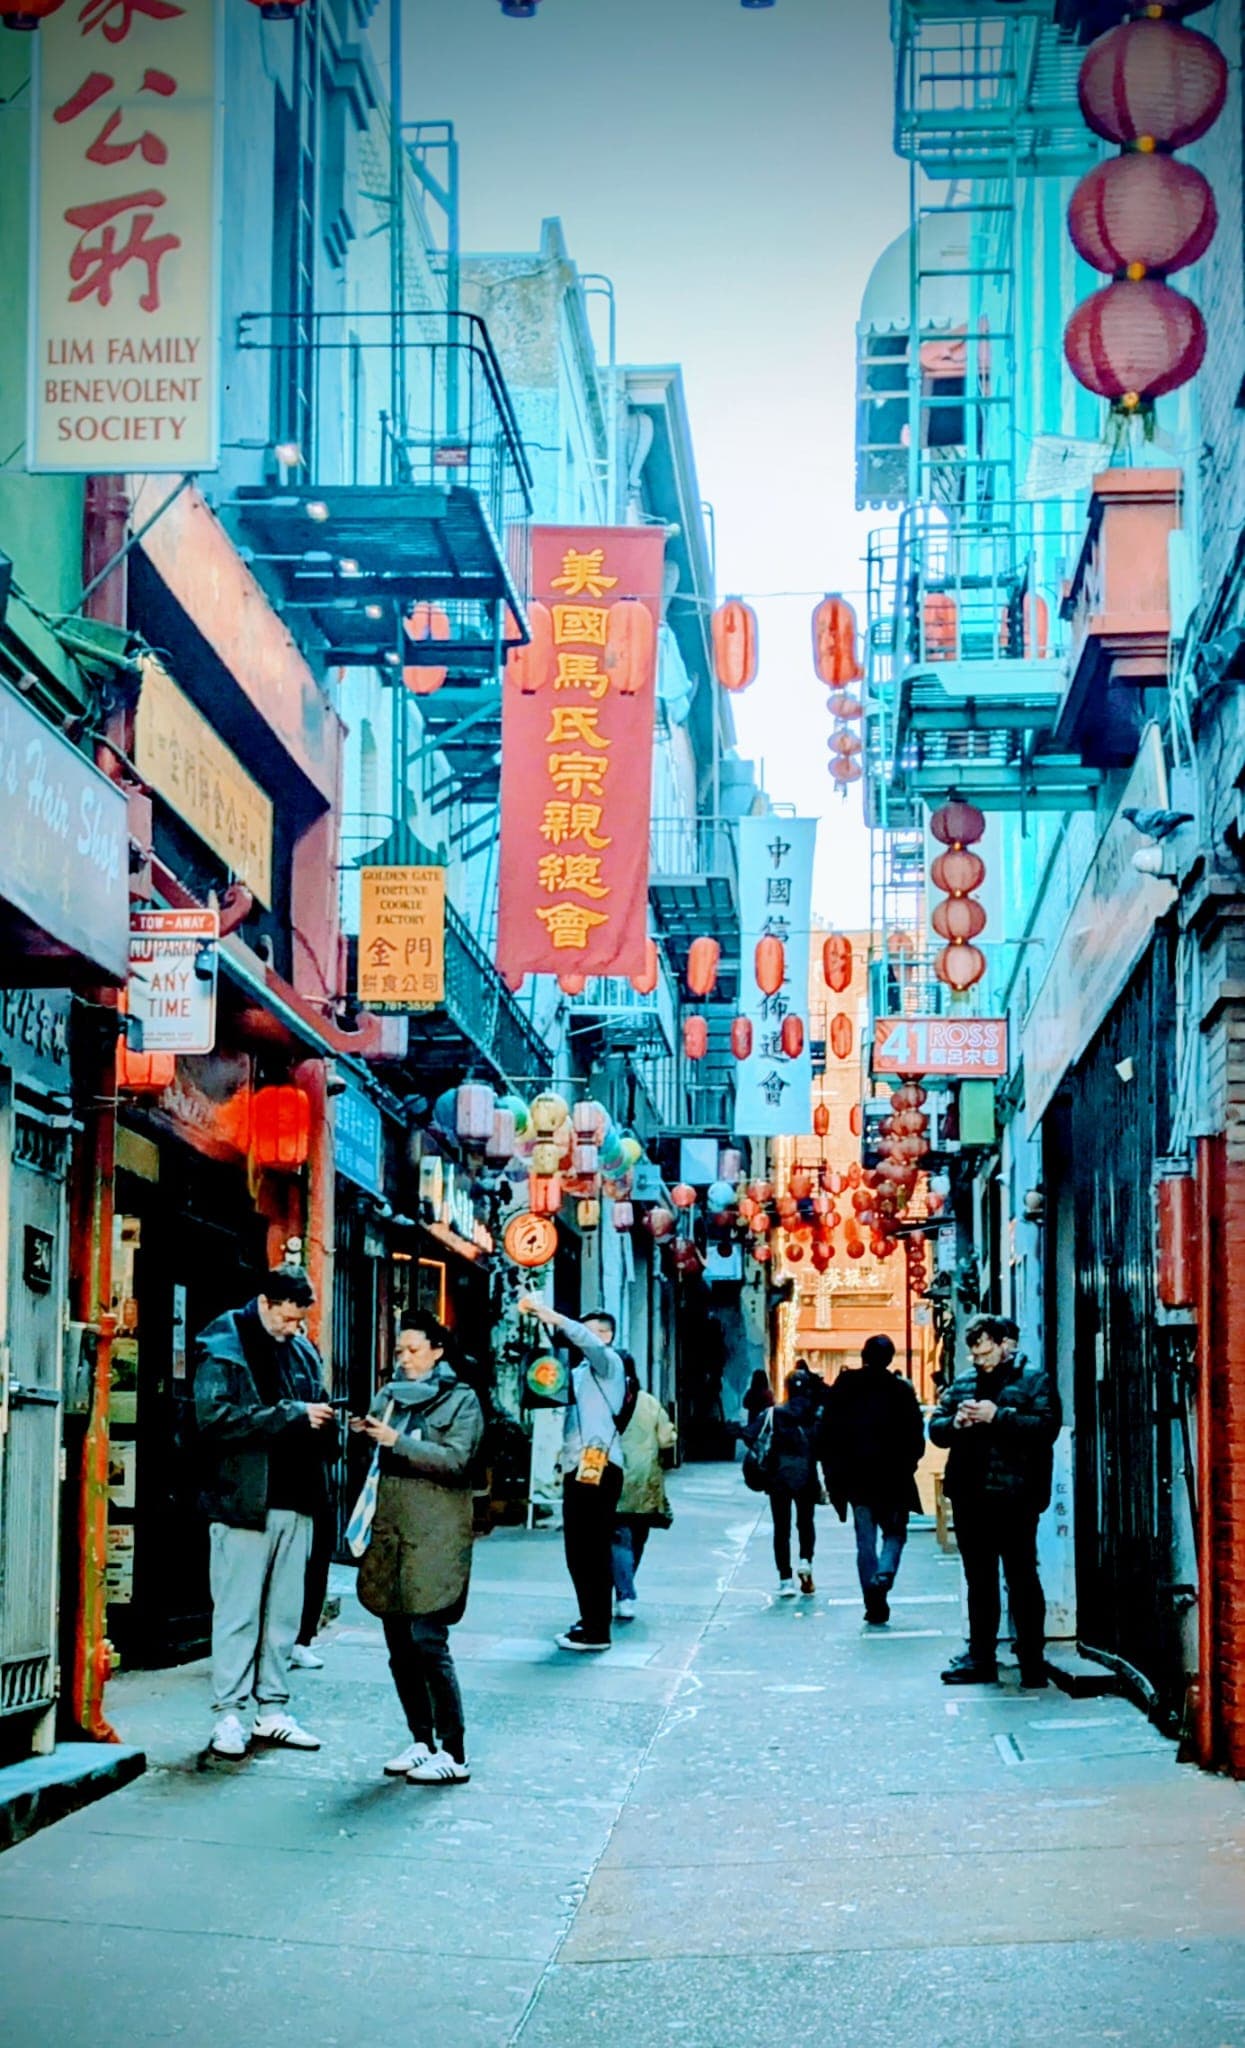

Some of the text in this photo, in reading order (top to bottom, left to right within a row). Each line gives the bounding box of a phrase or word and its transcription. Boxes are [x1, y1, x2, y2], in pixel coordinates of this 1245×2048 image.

[46, 338, 200, 365] LIM FAMILY
[44, 379, 202, 404] BENEVOLENT
[57, 417, 187, 442] SOCIETY
[535, 548, 618, 950] 美國馬氏宗親總會
[362, 871, 441, 881] GOLDEN GATE
[375, 886, 428, 896] FORTUNE
[380, 900, 423, 910] COOKIE
[376, 915, 425, 925] FACTORY
[130, 939, 152, 957] NO
[367, 936, 432, 967] 金門
[151, 973, 190, 992] ANY
[757, 836, 792, 1107] 中國信佈道會
[147, 998, 191, 1018] TIME
[881, 1022, 999, 1065] 41 ROSS
